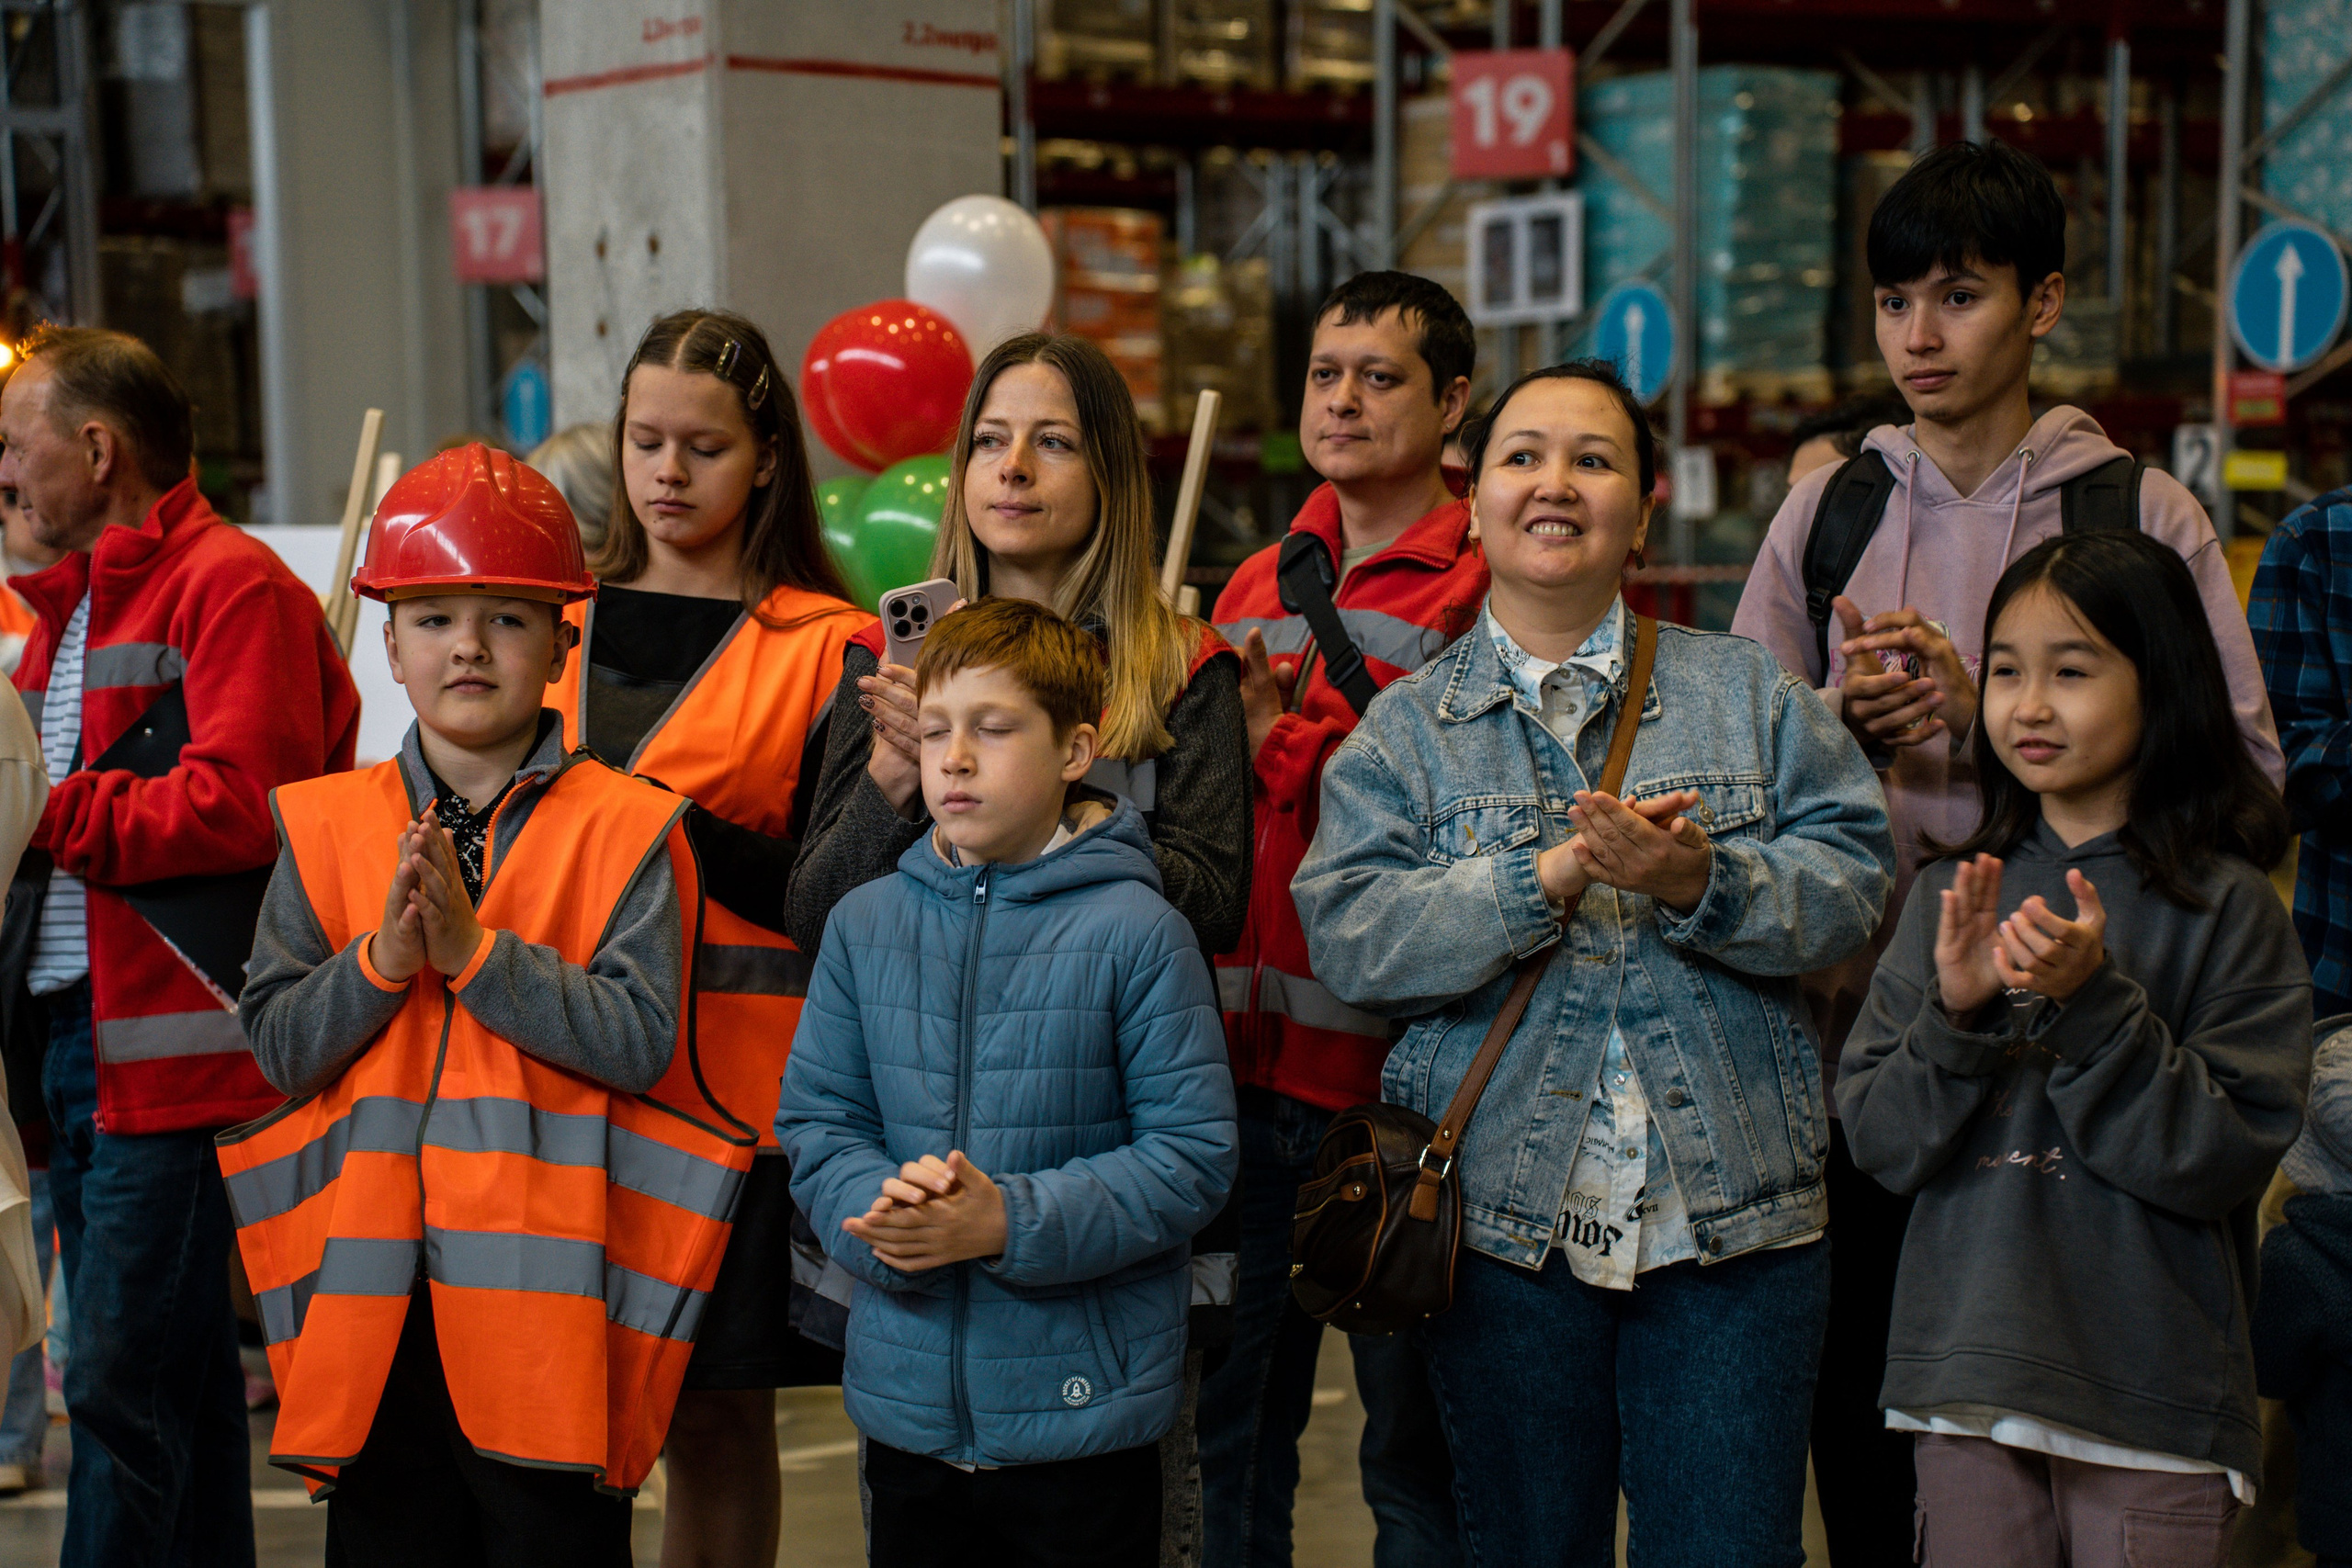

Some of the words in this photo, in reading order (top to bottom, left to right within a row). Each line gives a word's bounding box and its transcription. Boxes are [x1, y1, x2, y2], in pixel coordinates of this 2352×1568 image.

[1462, 74, 1554, 149] 19
[460, 206, 522, 260] 17
[1975, 1146, 2066, 1180] moent.
